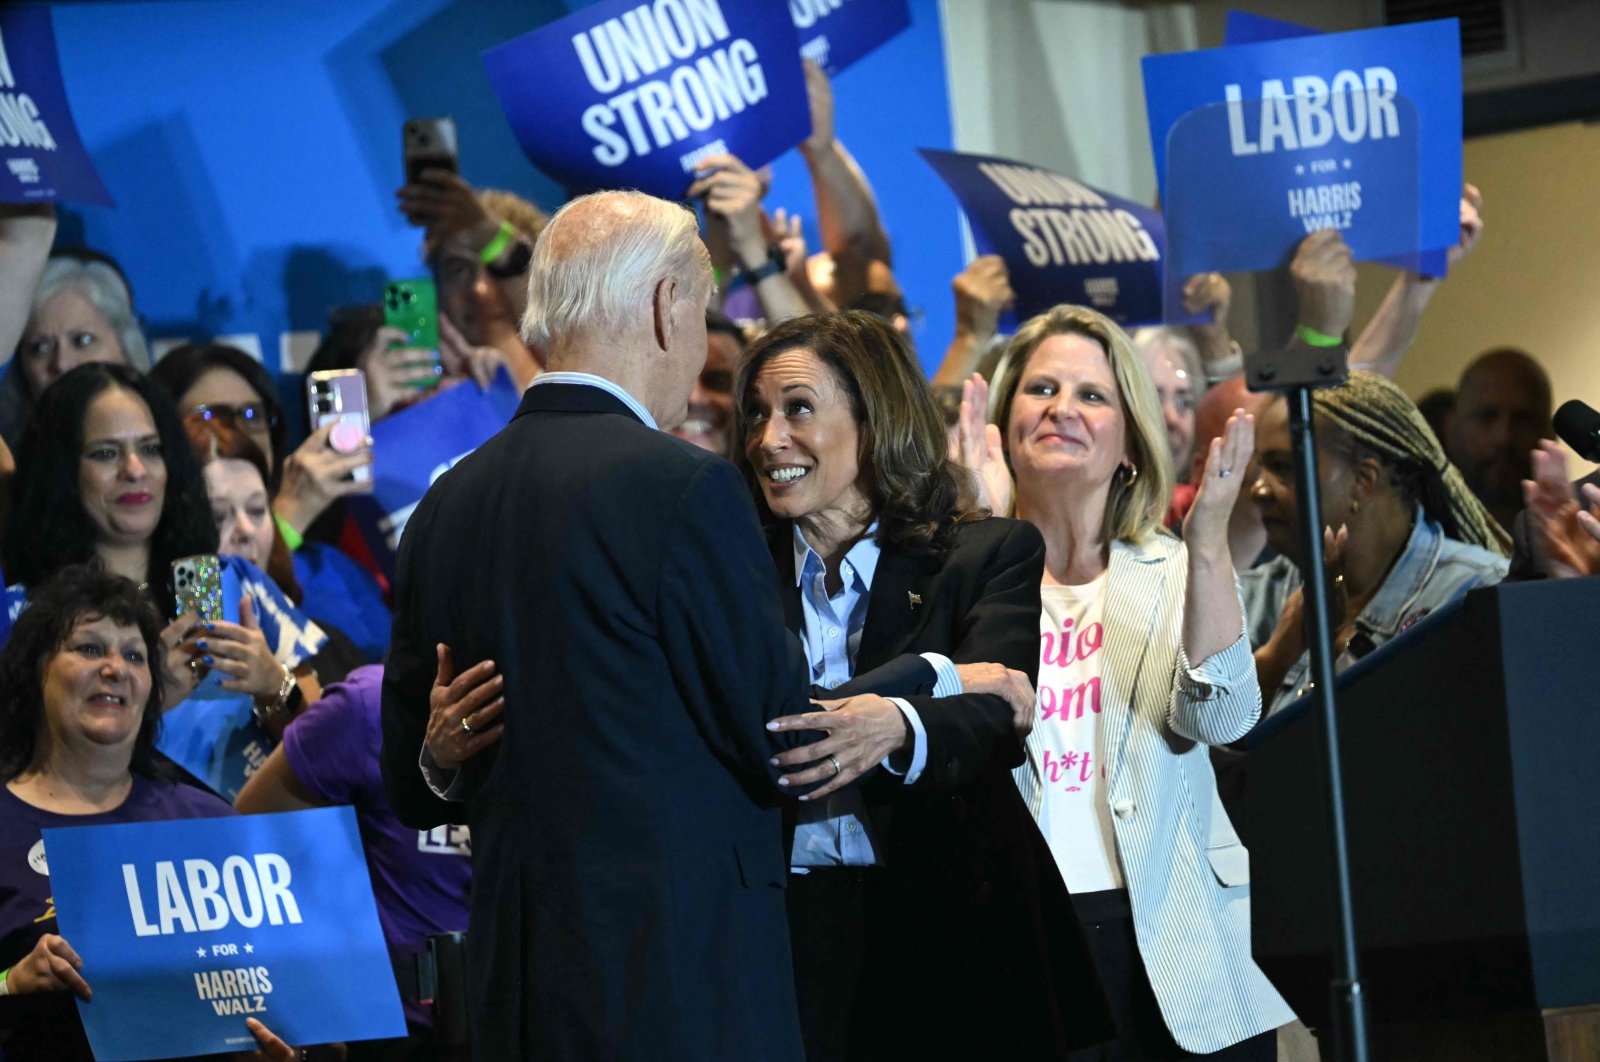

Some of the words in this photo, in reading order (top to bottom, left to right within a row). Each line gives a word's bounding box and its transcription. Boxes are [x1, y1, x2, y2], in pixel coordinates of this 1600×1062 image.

[572, 0, 730, 93] UNION
[581, 38, 768, 166] STRONG
[1224, 66, 1400, 156] LABOR
[1310, 159, 1338, 174] FOR
[1288, 181, 1362, 218] HARRIS
[1010, 207, 1160, 267] STRONG
[1302, 211, 1352, 233] WALZ
[122, 853, 303, 937] LABOR
[211, 943, 239, 957] FOR
[193, 966, 273, 1000] HARRIS
[211, 996, 267, 1017] WALZ
